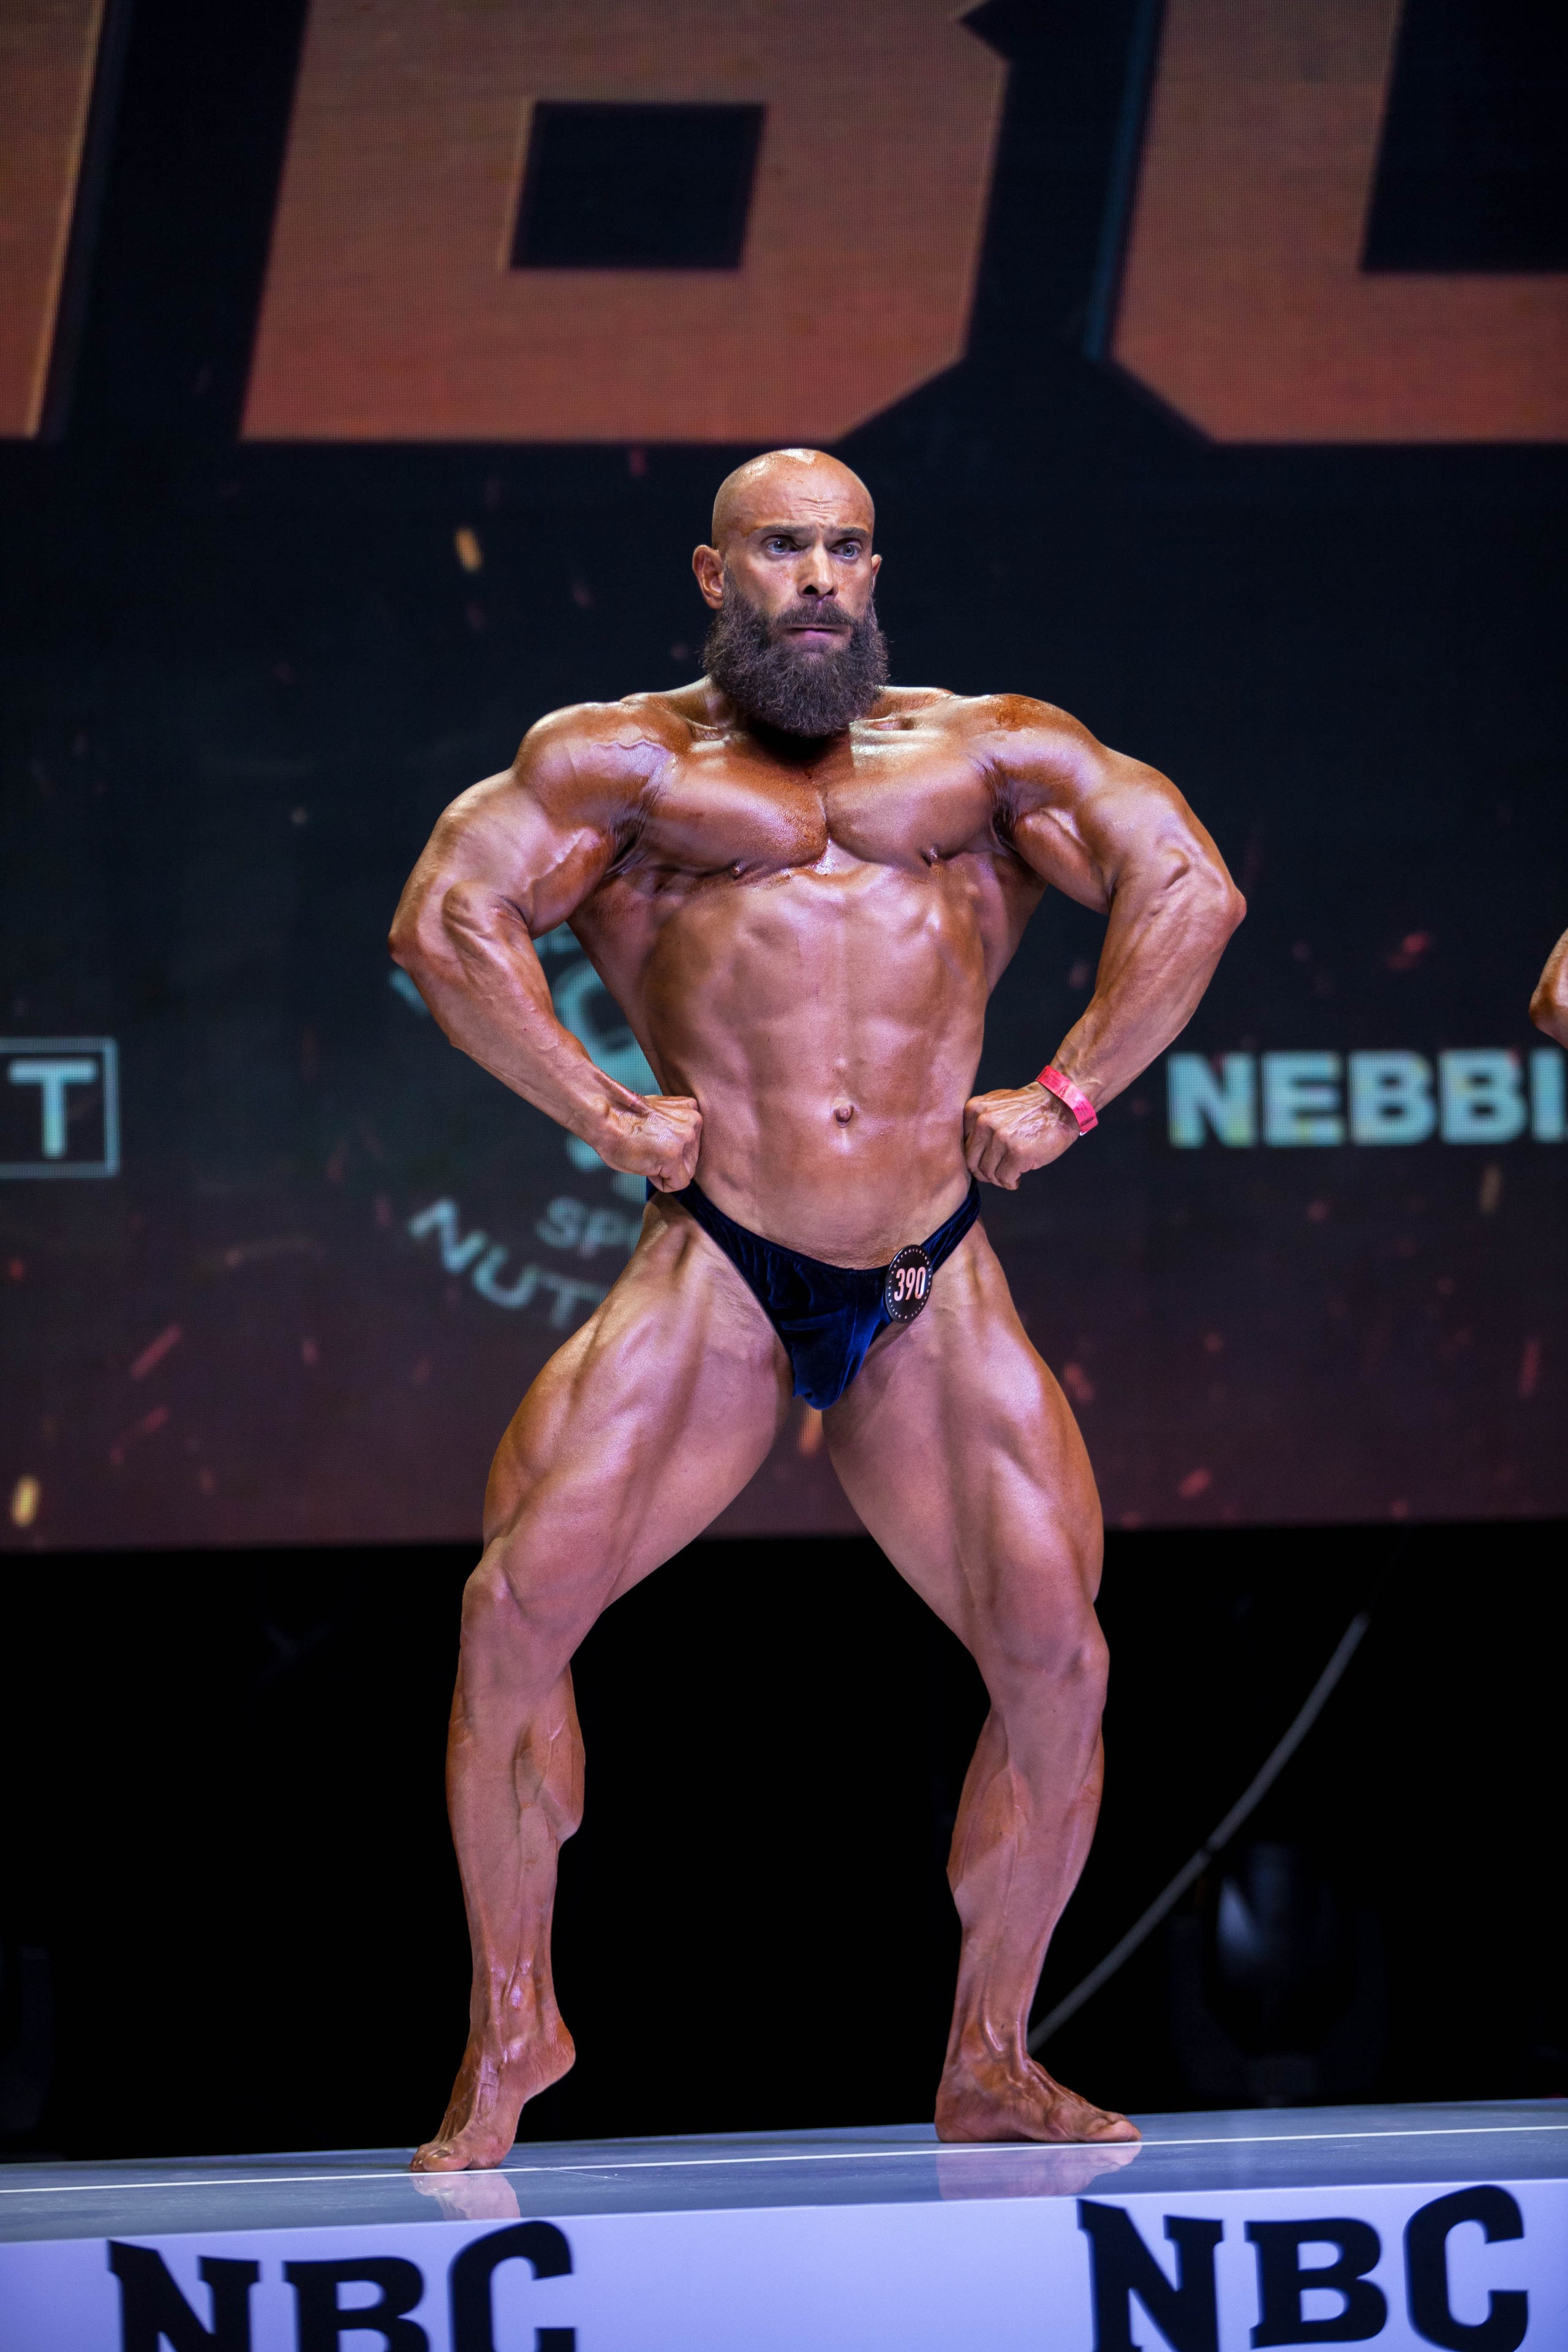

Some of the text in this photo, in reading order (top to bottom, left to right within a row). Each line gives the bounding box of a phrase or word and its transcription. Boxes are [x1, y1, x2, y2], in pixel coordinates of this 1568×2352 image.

[1167, 1048, 1566, 1148] NEBBI
[535, 1195, 643, 1259] SP
[894, 1266, 926, 1302] 390
[107, 2221, 576, 2352] NBC
[1077, 2184, 1529, 2352] NBC
